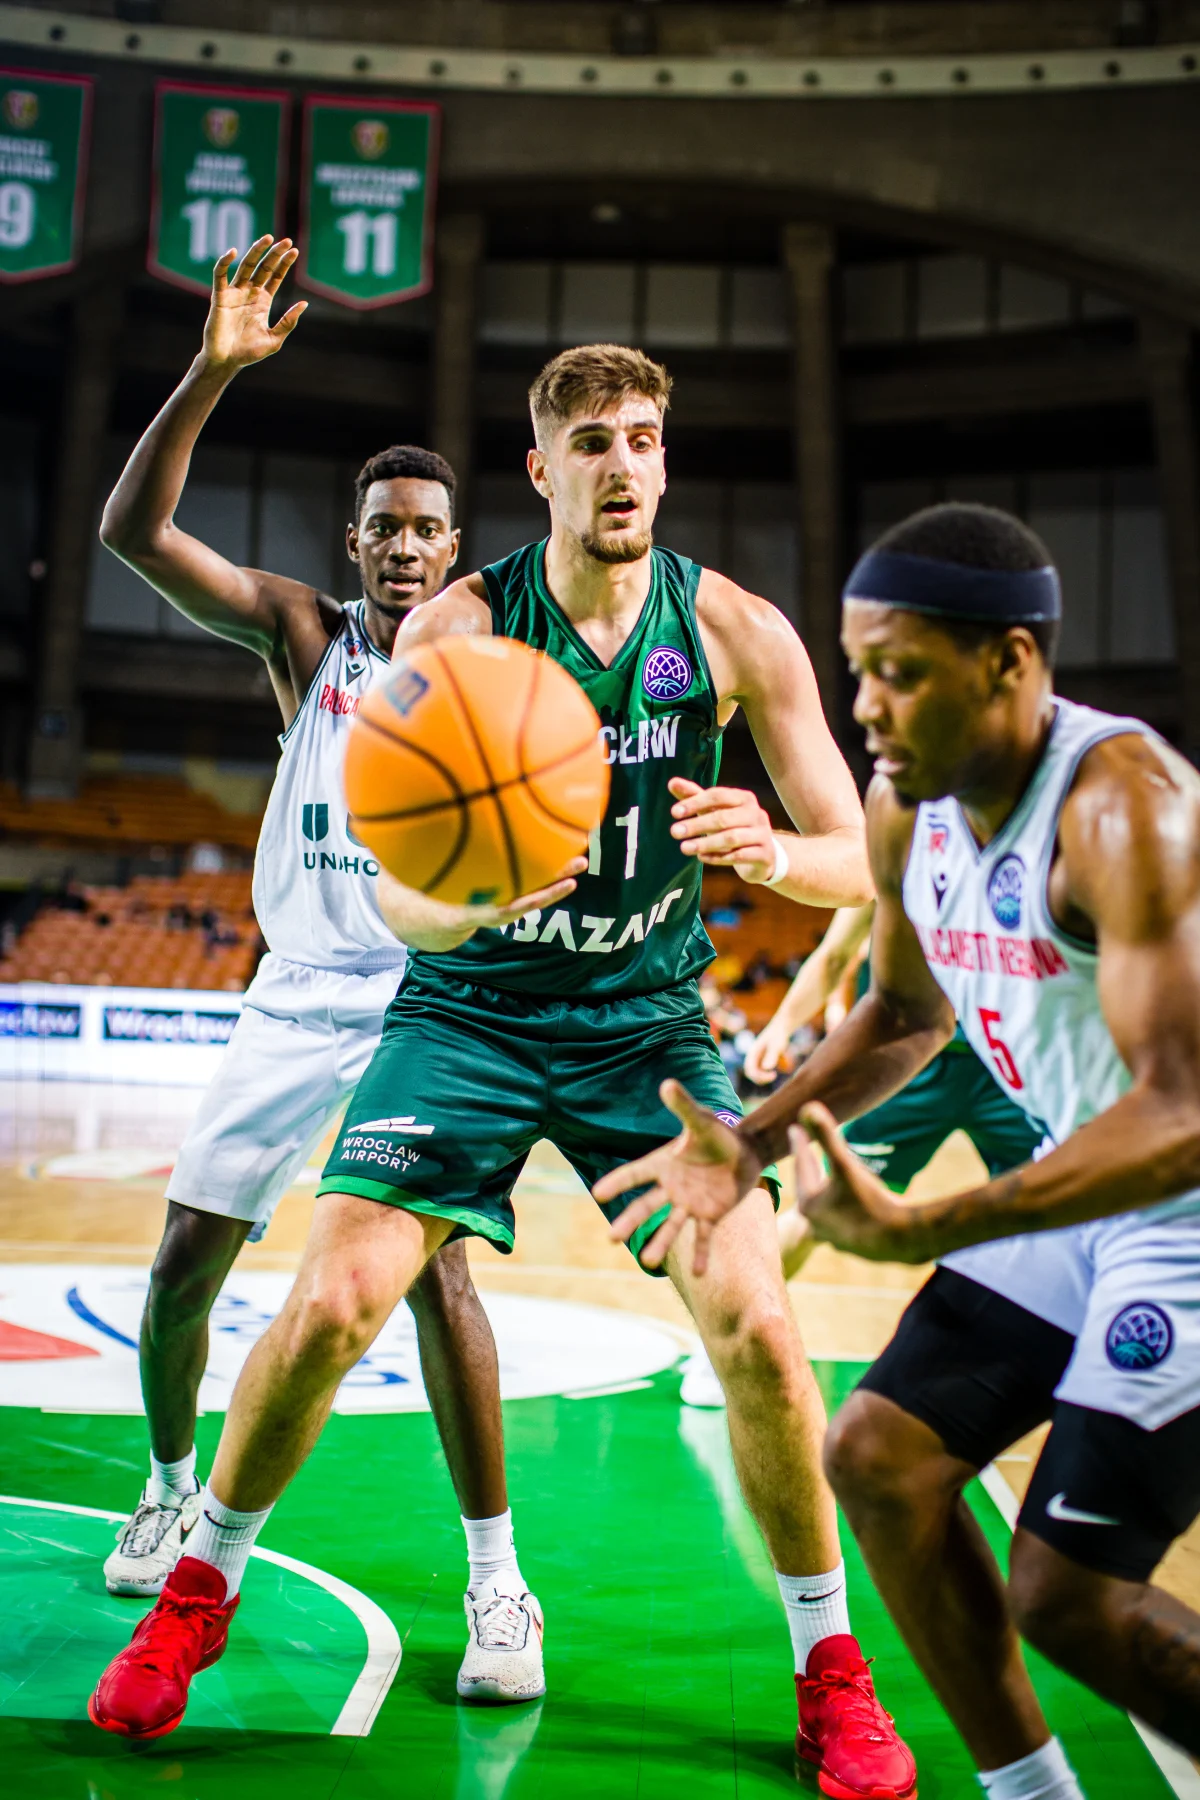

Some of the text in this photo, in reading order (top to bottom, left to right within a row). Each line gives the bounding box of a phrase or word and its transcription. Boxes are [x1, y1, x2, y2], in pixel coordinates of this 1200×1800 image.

[0, 182, 36, 248] 9
[181, 198, 254, 264] 10
[336, 211, 399, 278] 11
[978, 1008, 1024, 1090] 5
[341, 1149, 410, 1172] AIRPORT
[342, 1137, 420, 1163] WROCLAW
